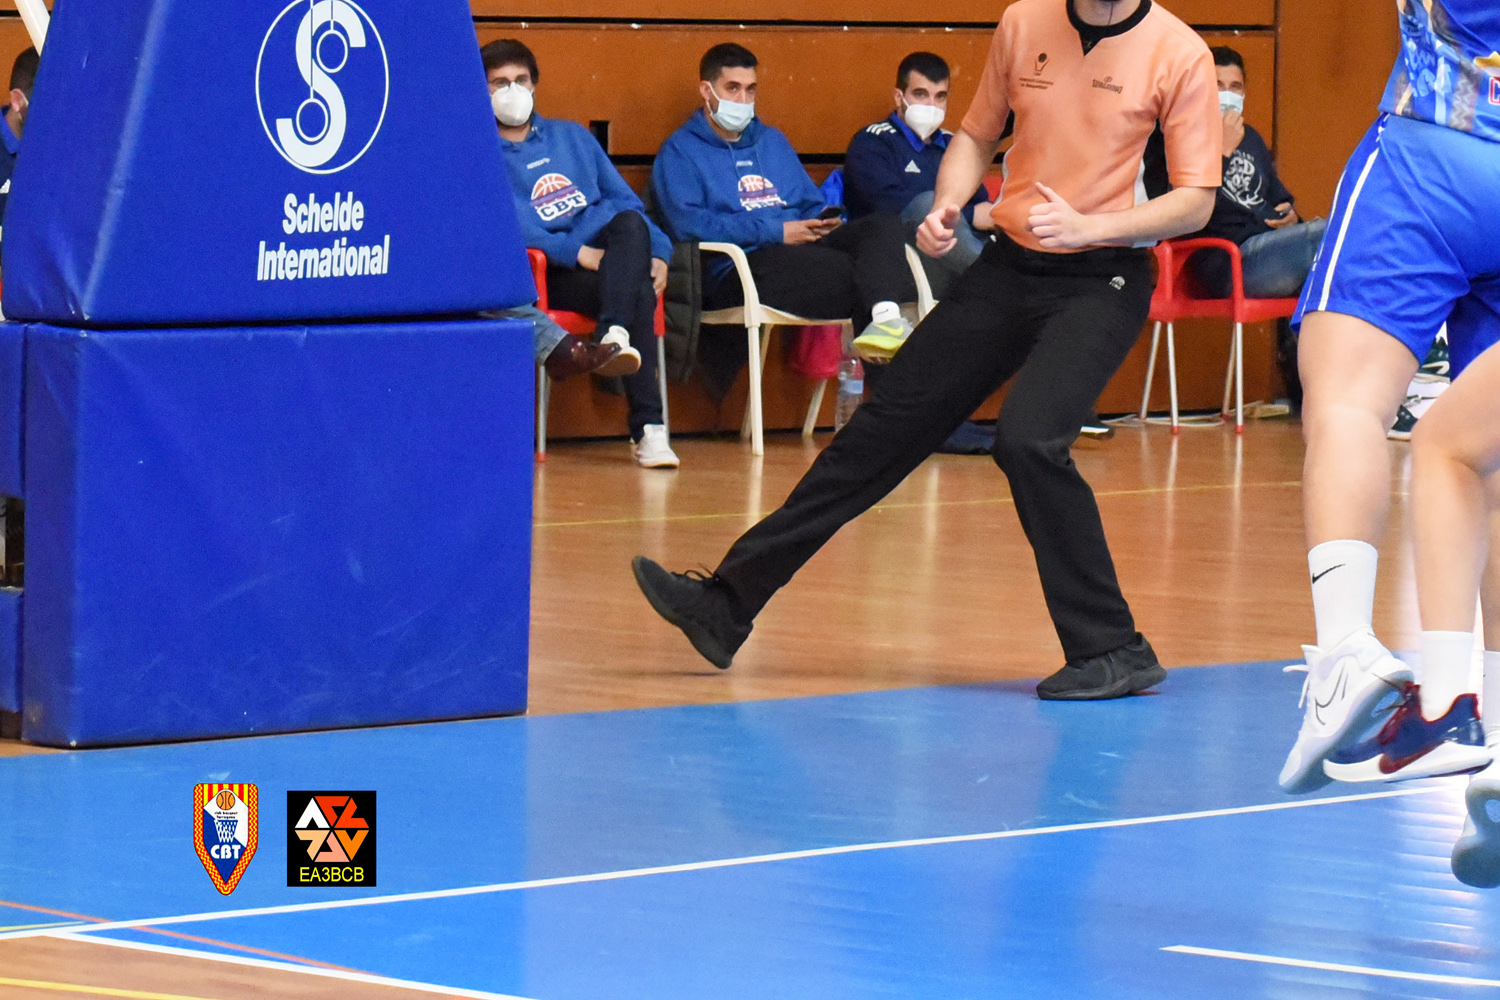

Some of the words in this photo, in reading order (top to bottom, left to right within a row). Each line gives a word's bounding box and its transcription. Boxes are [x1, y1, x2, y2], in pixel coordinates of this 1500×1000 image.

[283, 191, 365, 235] Schelde
[538, 191, 587, 220] CBT
[257, 234, 391, 281] International
